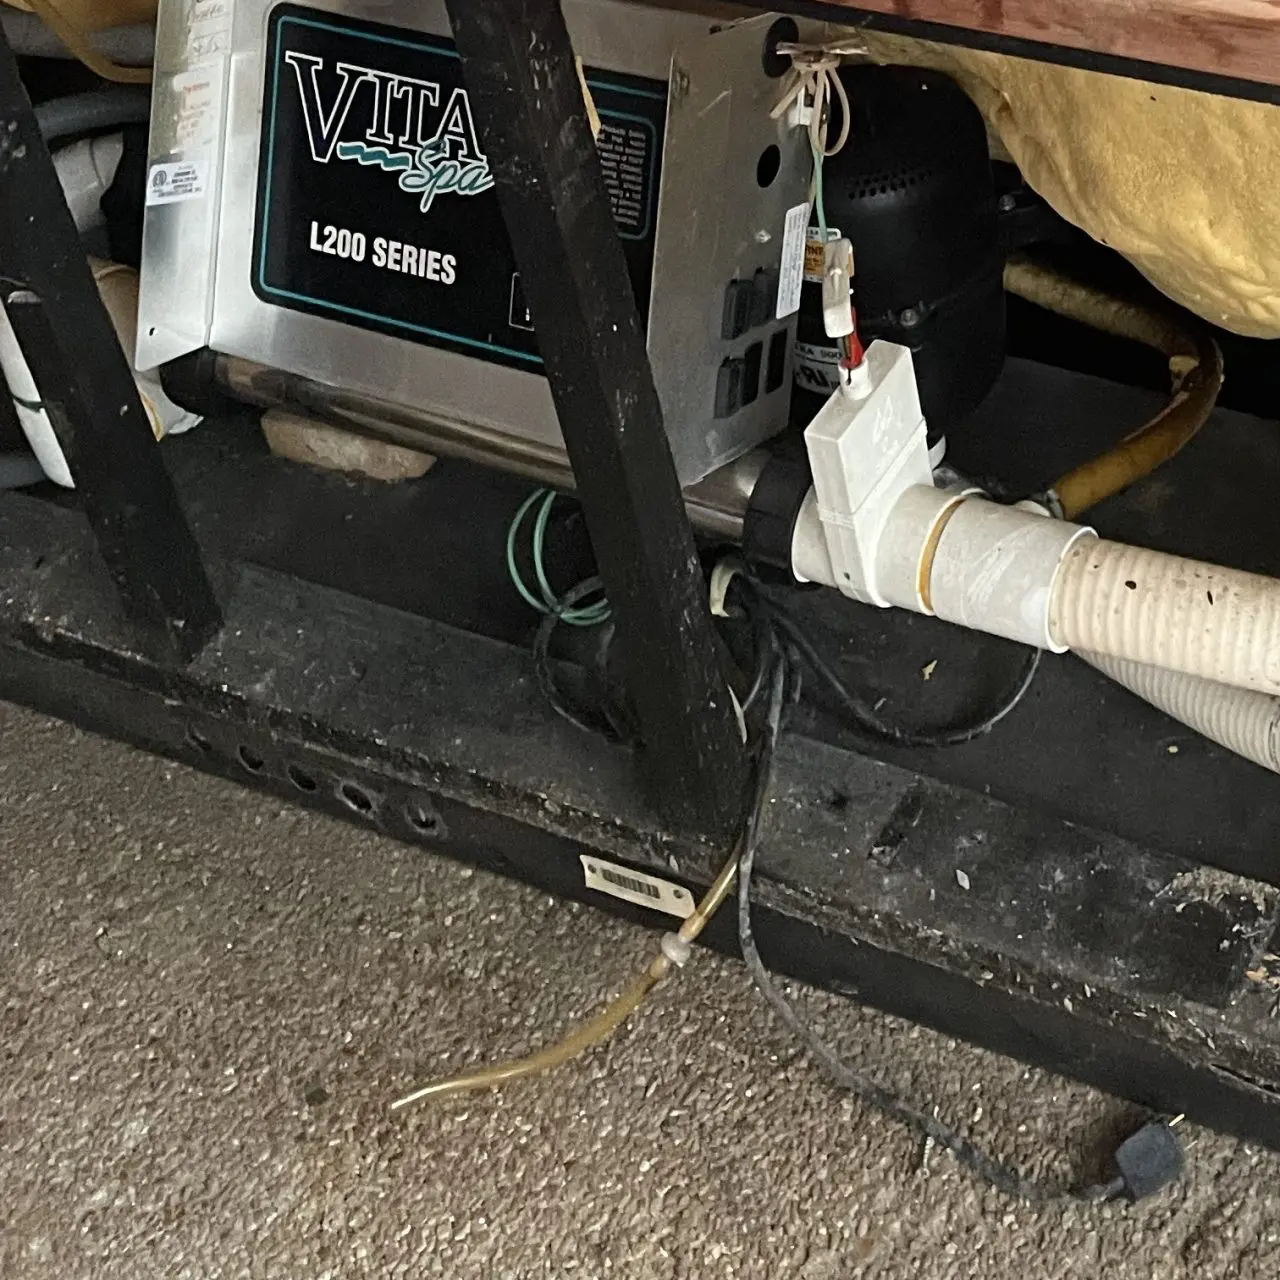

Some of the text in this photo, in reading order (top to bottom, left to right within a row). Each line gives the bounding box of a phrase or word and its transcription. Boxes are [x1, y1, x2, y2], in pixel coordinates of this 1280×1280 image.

[285, 51, 487, 164] VITA
[398, 138, 496, 213] Spa
[309, 220, 457, 285] L200 SERIES
